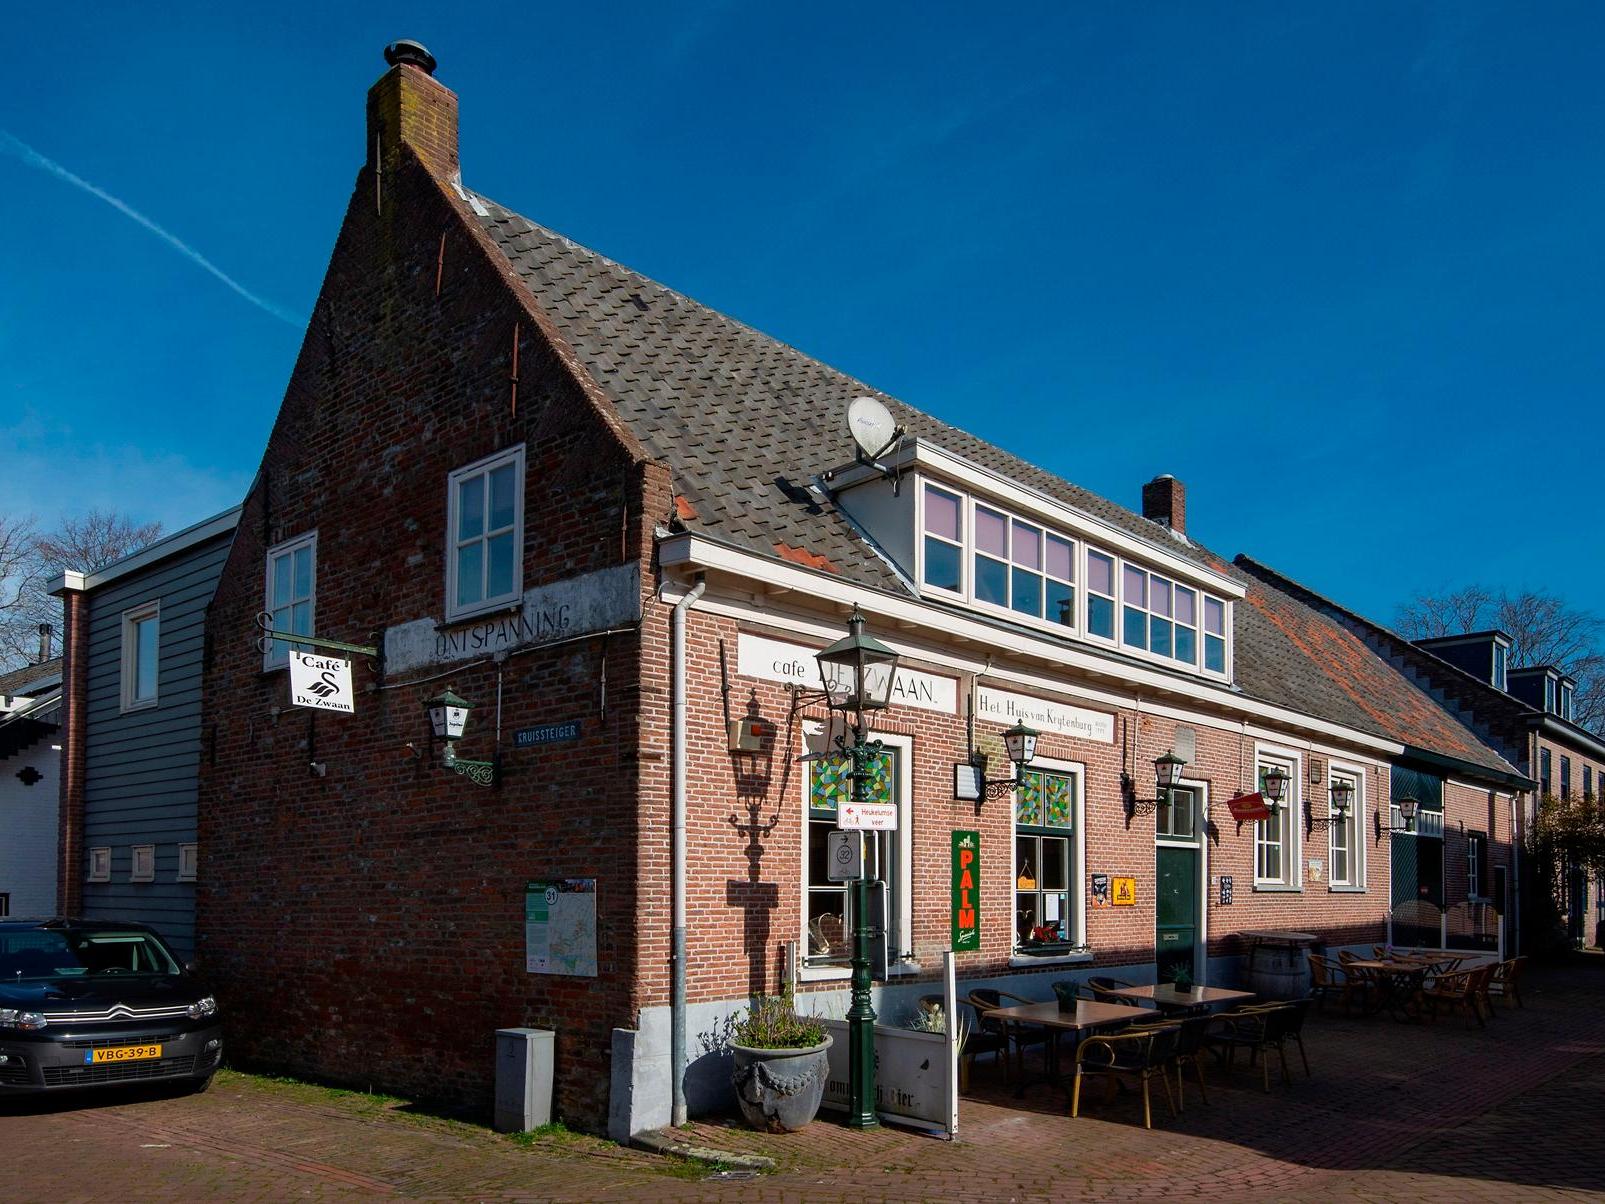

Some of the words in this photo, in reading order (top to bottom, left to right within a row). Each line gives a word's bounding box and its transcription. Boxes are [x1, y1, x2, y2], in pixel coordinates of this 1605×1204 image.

[302, 656, 340, 672] Café
[773, 660, 806, 678] cafe
[296, 695, 312, 705] De
[315, 697, 351, 711] Zwaan
[979, 694, 1001, 714] Het
[1006, 700, 1029, 719] Huis
[1030, 711, 1045, 723] van
[517, 724, 577, 744] KRUISSTEIGER
[838, 848, 851, 859] 32
[546, 890, 555, 901] 31
[958, 849, 975, 929] PALM
[97, 1047, 156, 1060] VBG-39-B
